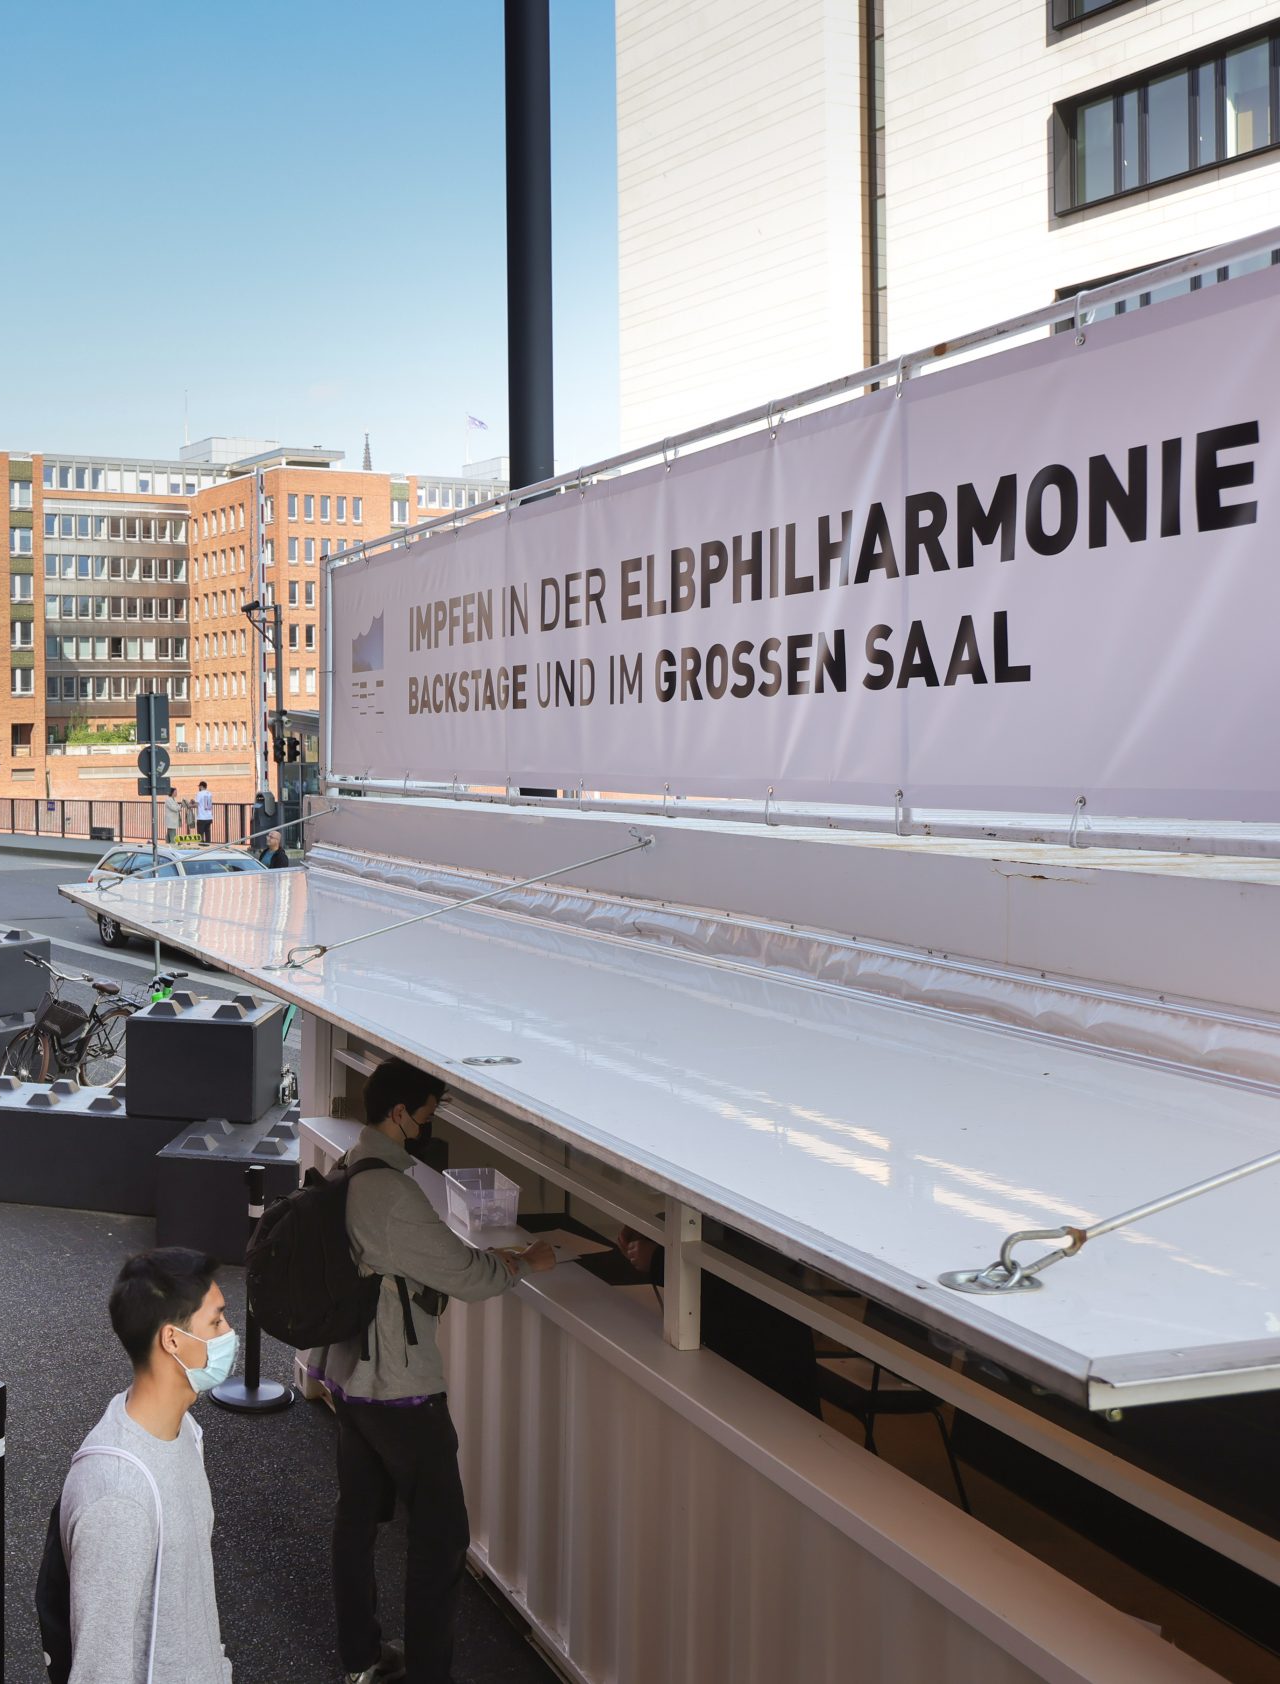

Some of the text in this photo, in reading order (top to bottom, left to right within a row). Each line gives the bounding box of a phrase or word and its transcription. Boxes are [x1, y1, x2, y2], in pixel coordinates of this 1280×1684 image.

[408, 420, 1260, 652] IMPFEN IN DER ELBPHILHARMONIE
[408, 610, 1031, 715] BACKSTAGE UND IM GROSSEN SAAL
